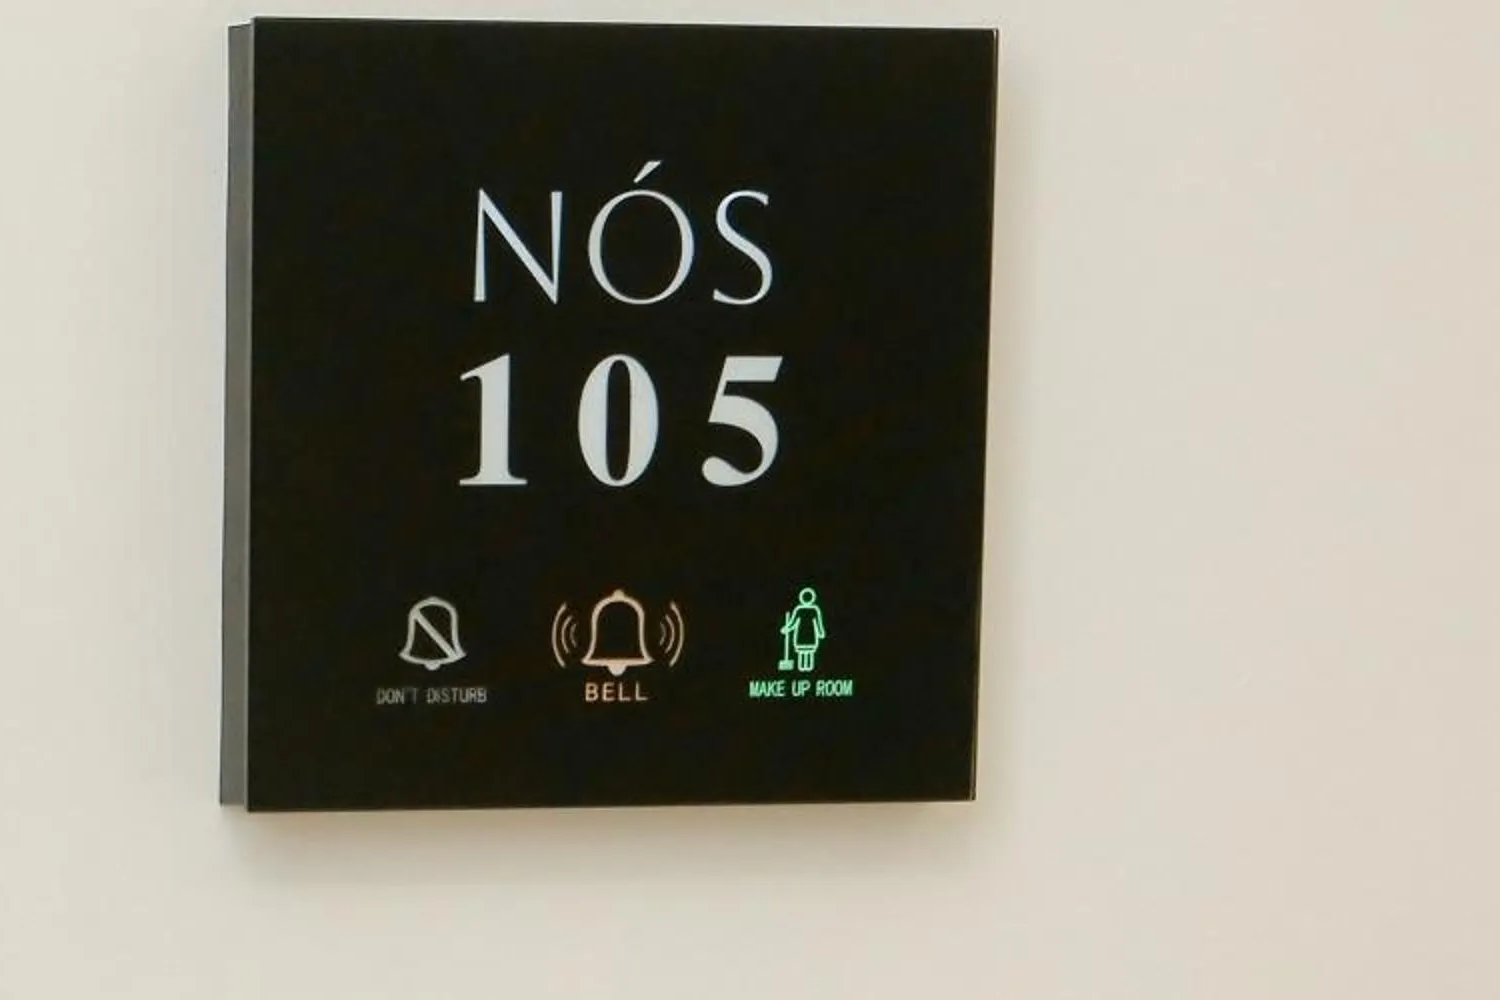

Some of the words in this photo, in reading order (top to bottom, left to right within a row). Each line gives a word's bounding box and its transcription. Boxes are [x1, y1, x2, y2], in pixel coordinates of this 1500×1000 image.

[473, 159, 774, 306] NÓS
[458, 353, 784, 487] 105
[376, 687, 419, 705] DON'T
[426, 687, 487, 704] DISTURB
[584, 681, 649, 703] BELL
[748, 680, 789, 698] MAKE
[791, 680, 811, 698] UP
[815, 679, 854, 697] ROOM
